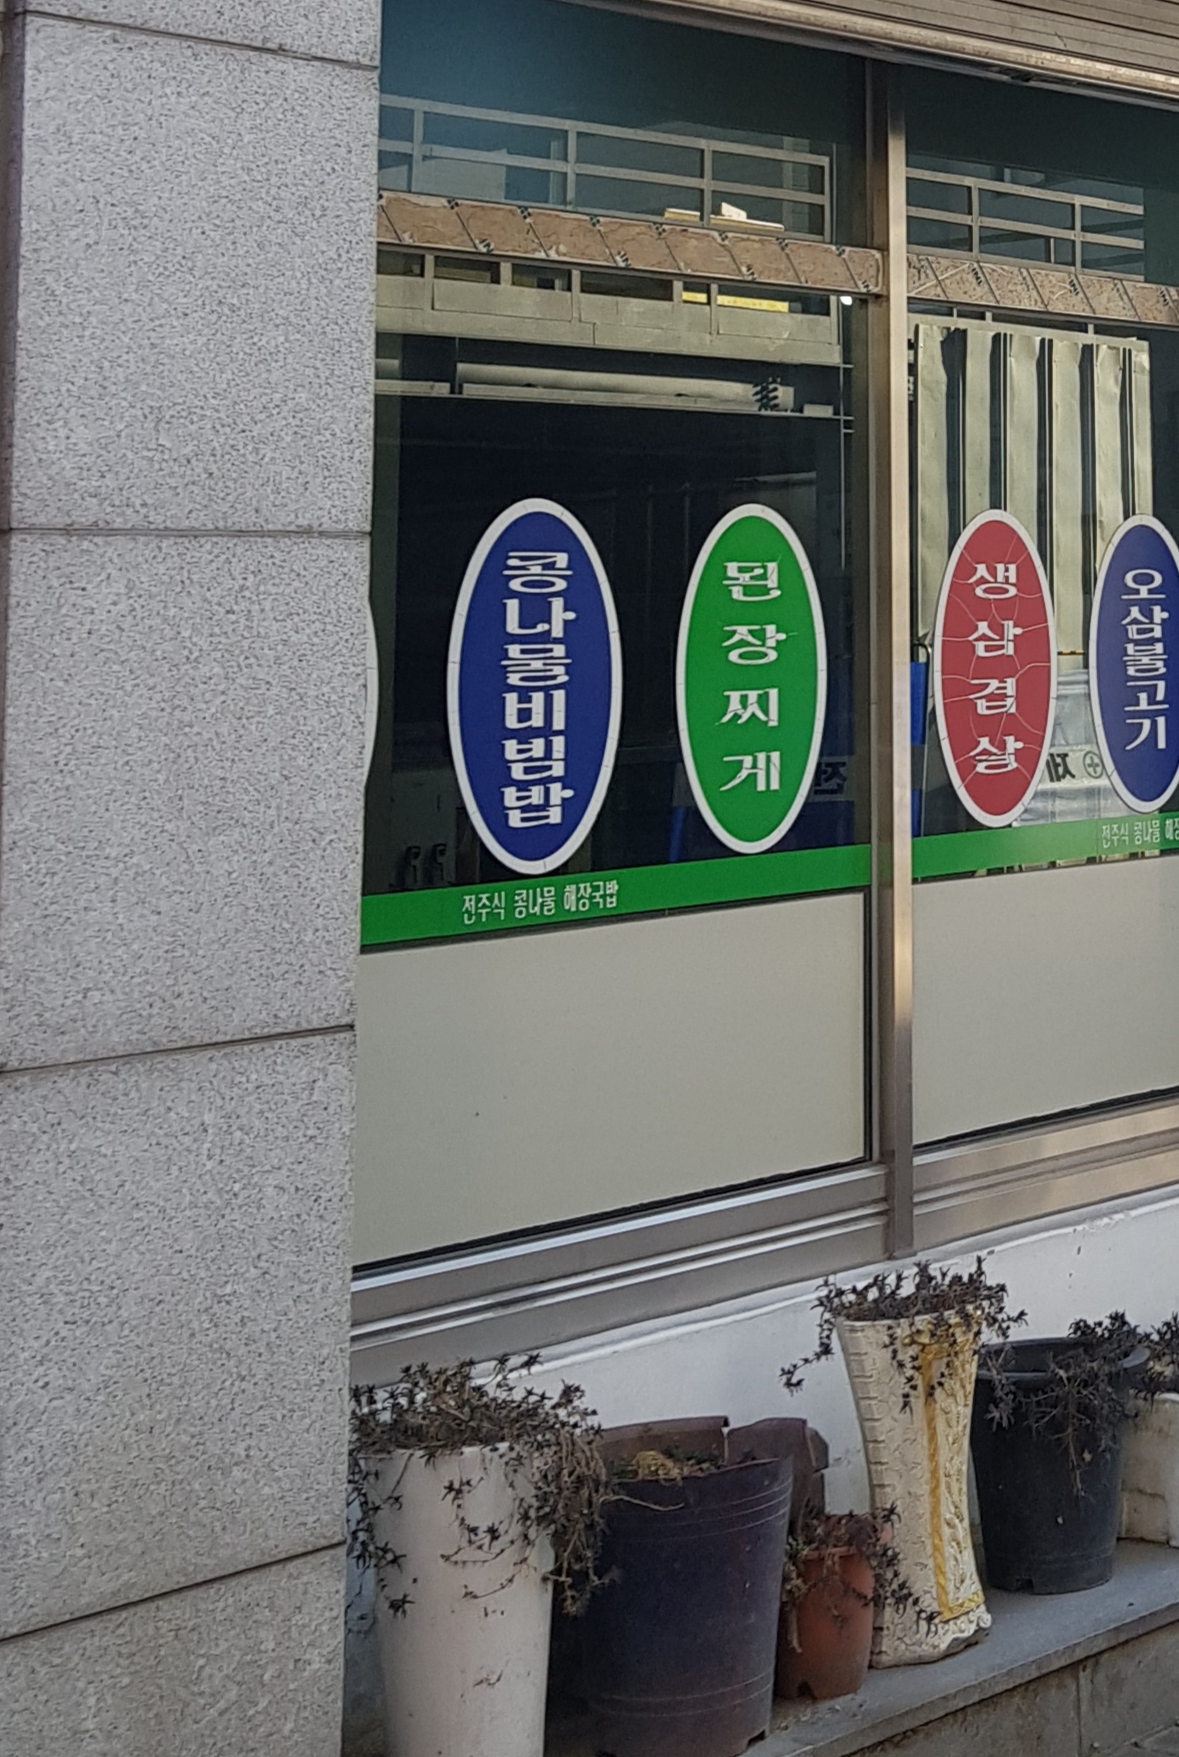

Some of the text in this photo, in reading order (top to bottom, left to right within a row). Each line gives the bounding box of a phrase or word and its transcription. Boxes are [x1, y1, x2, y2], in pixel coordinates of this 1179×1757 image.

[500, 551, 577, 828] 콩나물비빔밥
[967, 562, 1025, 775] 생삼겹살
[1120, 568, 1169, 751] 오삼불고기
[462, 879, 619, 925] 전주식 콩나물 해장국밥
[1102, 823, 1129, 849] 전주식
[1134, 819, 1160, 845] 콩나물
